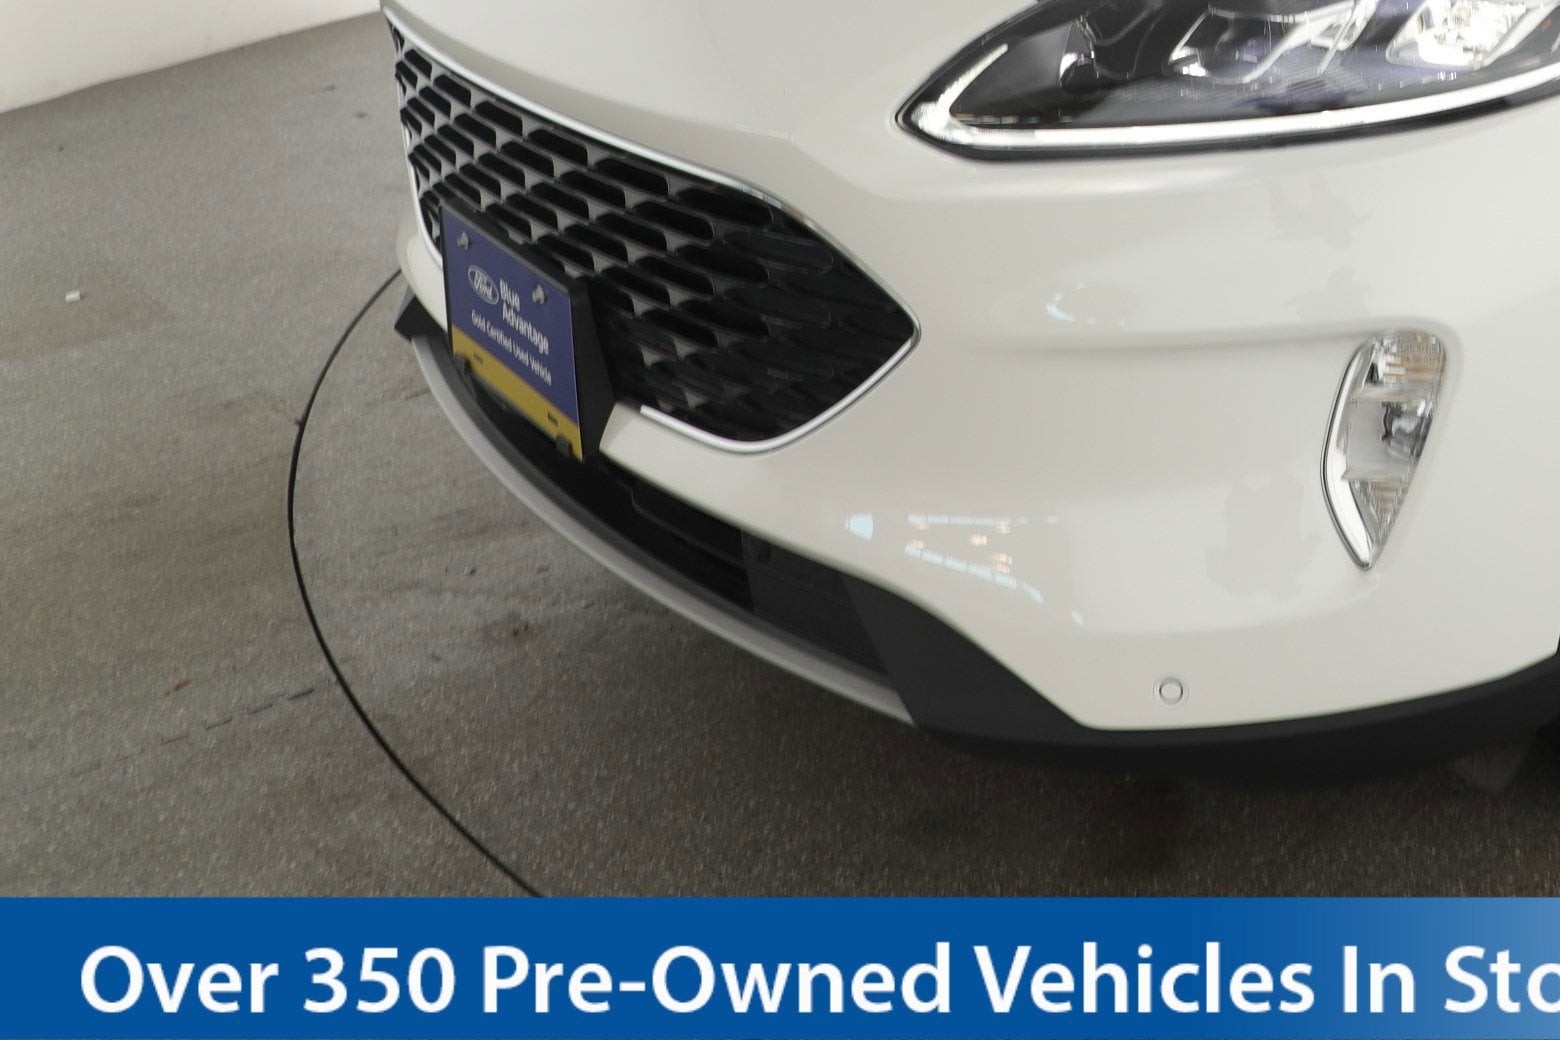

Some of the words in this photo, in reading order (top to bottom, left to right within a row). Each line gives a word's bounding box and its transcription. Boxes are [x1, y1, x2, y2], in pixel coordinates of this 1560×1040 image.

[473, 269, 493, 301] Ford
[499, 277, 520, 312] Blue
[502, 301, 549, 356] Advantage
[486, 320, 513, 353] Certified
[512, 340, 529, 367] Used
[529, 353, 551, 387] Vehicle
